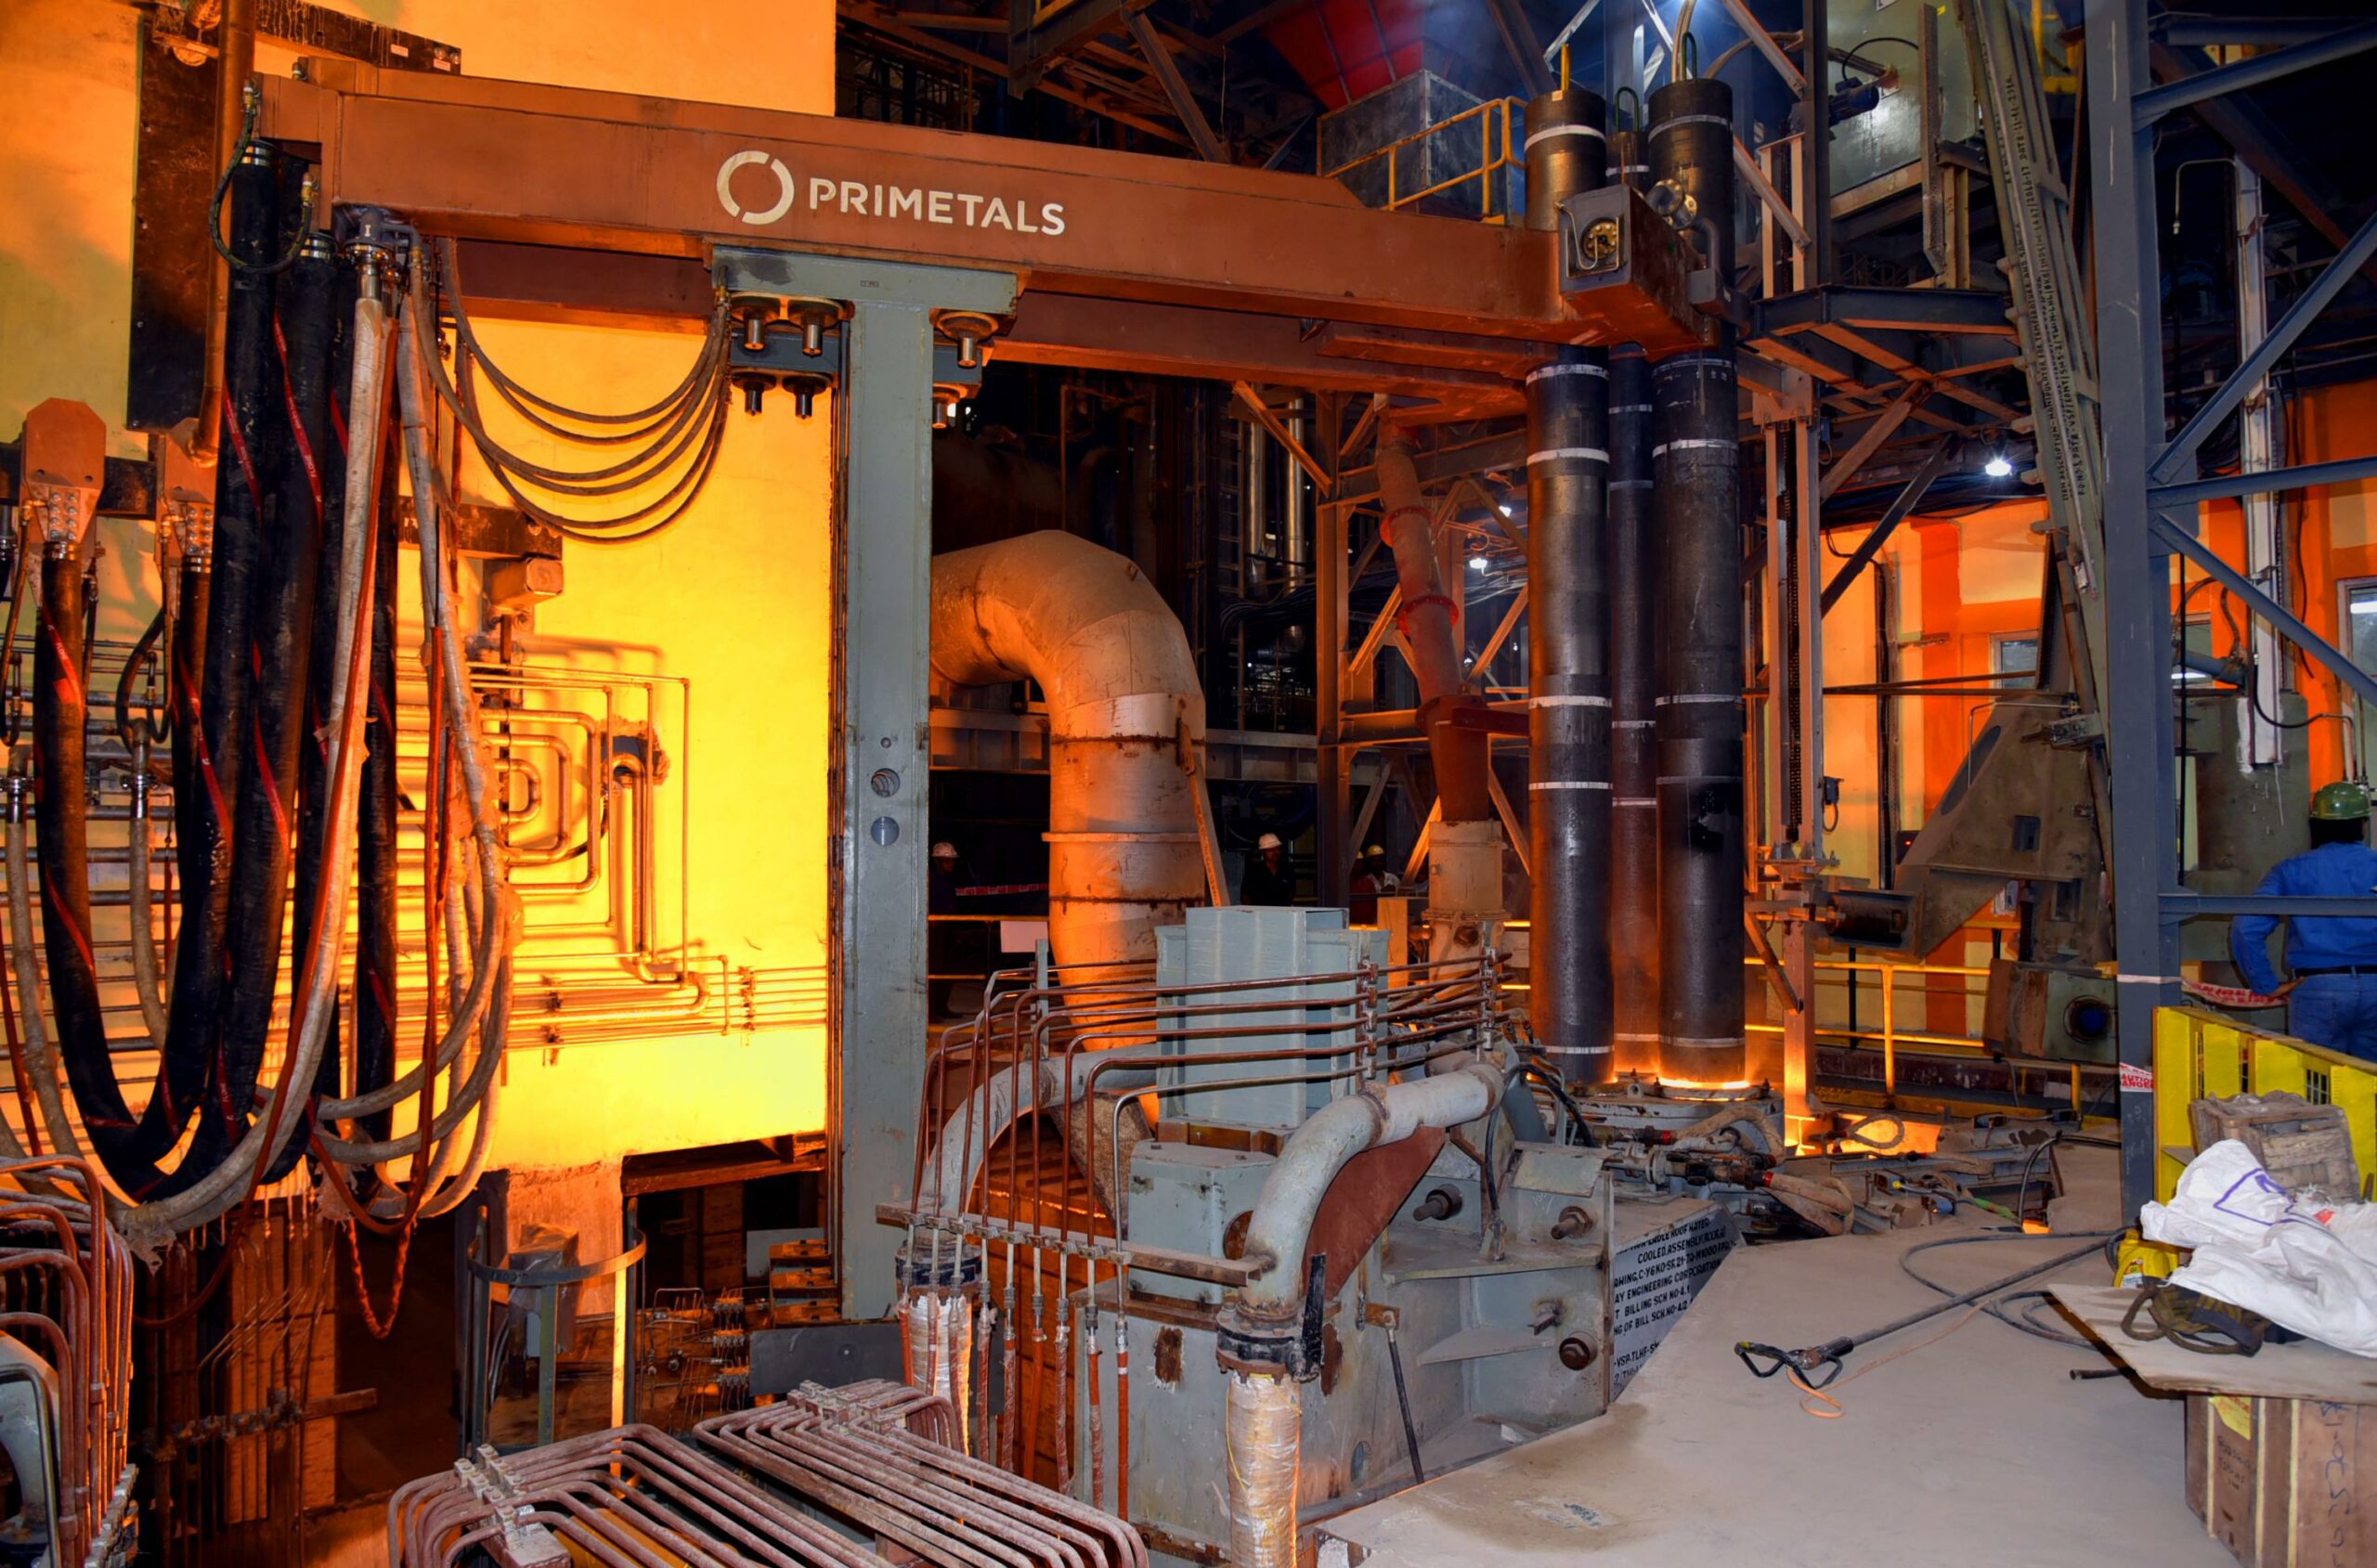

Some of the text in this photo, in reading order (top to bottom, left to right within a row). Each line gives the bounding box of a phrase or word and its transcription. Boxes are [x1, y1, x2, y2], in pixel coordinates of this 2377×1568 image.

[810, 177, 1066, 236] PRIMETALS
[1627, 1276, 1672, 1300] ENGINEERING
[1625, 1298, 1652, 1316] BILLING
[1624, 1319, 1634, 1333] OF
[1635, 1315, 1649, 1328] BILL
